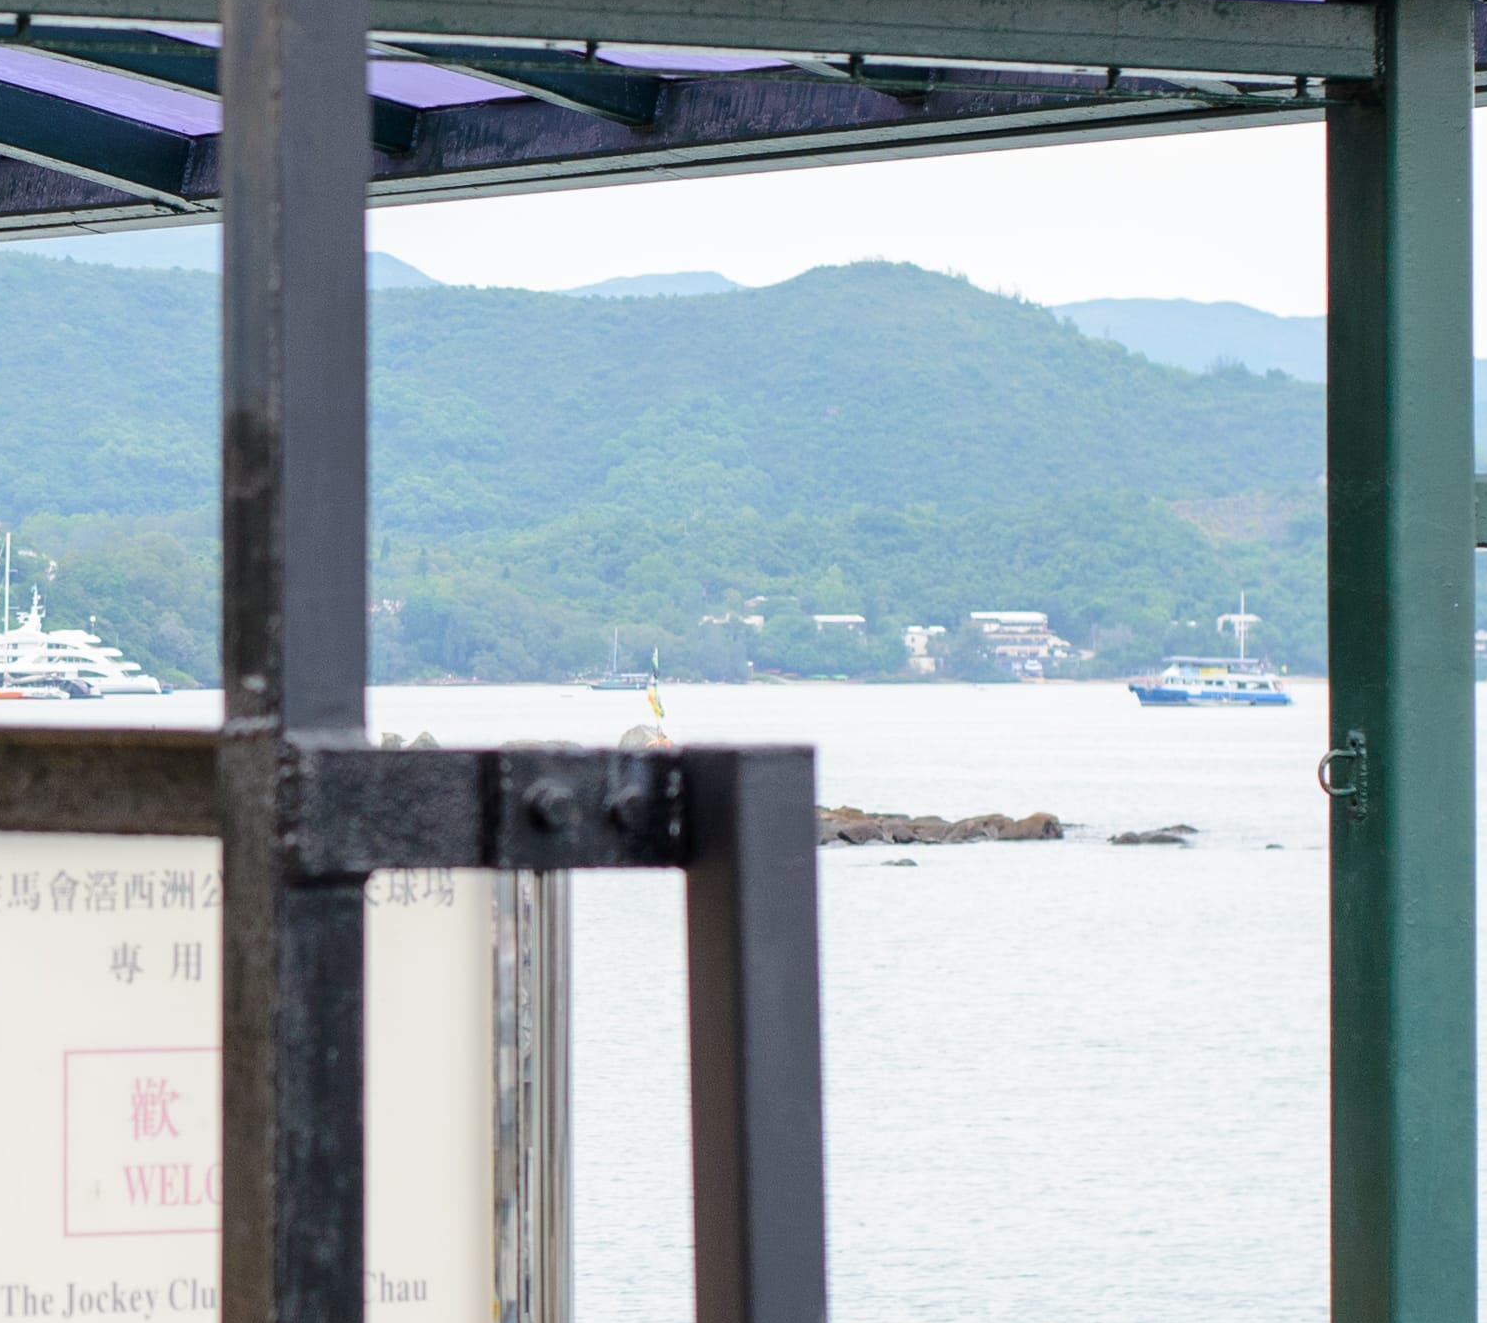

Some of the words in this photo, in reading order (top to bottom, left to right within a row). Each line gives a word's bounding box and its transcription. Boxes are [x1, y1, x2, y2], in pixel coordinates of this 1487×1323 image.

[123, 1162, 223, 1206] WELC
[0, 1283, 54, 1318] The
[62, 1280, 158, 1321] Jockey
[168, 1276, 220, 1312] Clu
